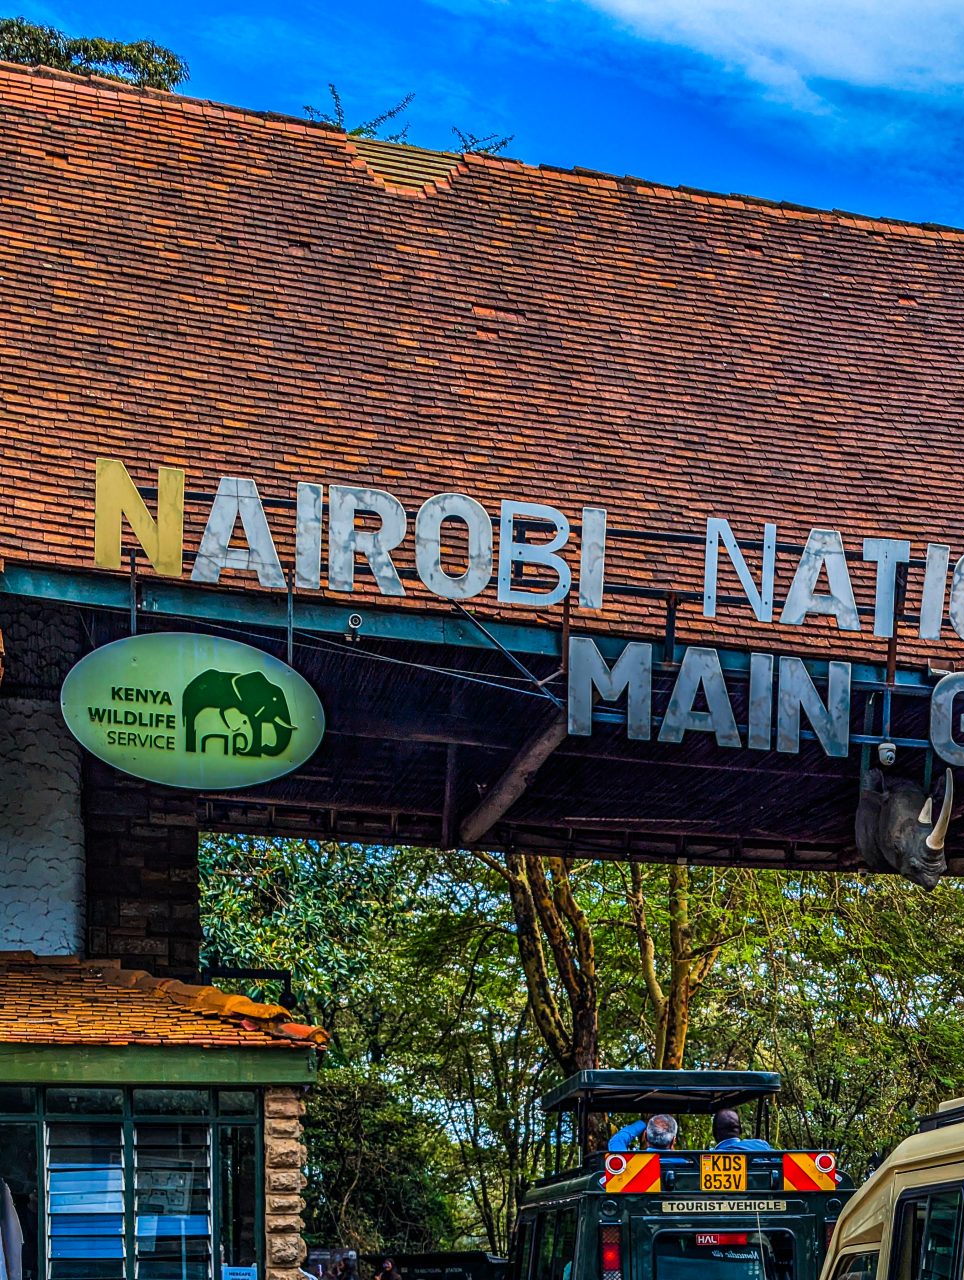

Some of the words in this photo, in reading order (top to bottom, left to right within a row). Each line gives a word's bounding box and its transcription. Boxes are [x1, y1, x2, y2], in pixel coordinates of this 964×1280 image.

[94, 457, 607, 609] NAIROBI
[111, 686, 173, 706] KENYA
[567, 636, 852, 757] MAIN
[87, 706, 176, 729] WILDLIFE
[106, 730, 176, 750] SERVICE
[711, 1155, 742, 1172] KDS
[703, 1173, 742, 1190] 853V
[667, 1201, 724, 1211] TOURIST
[727, 1201, 781, 1211] VEHICLE
